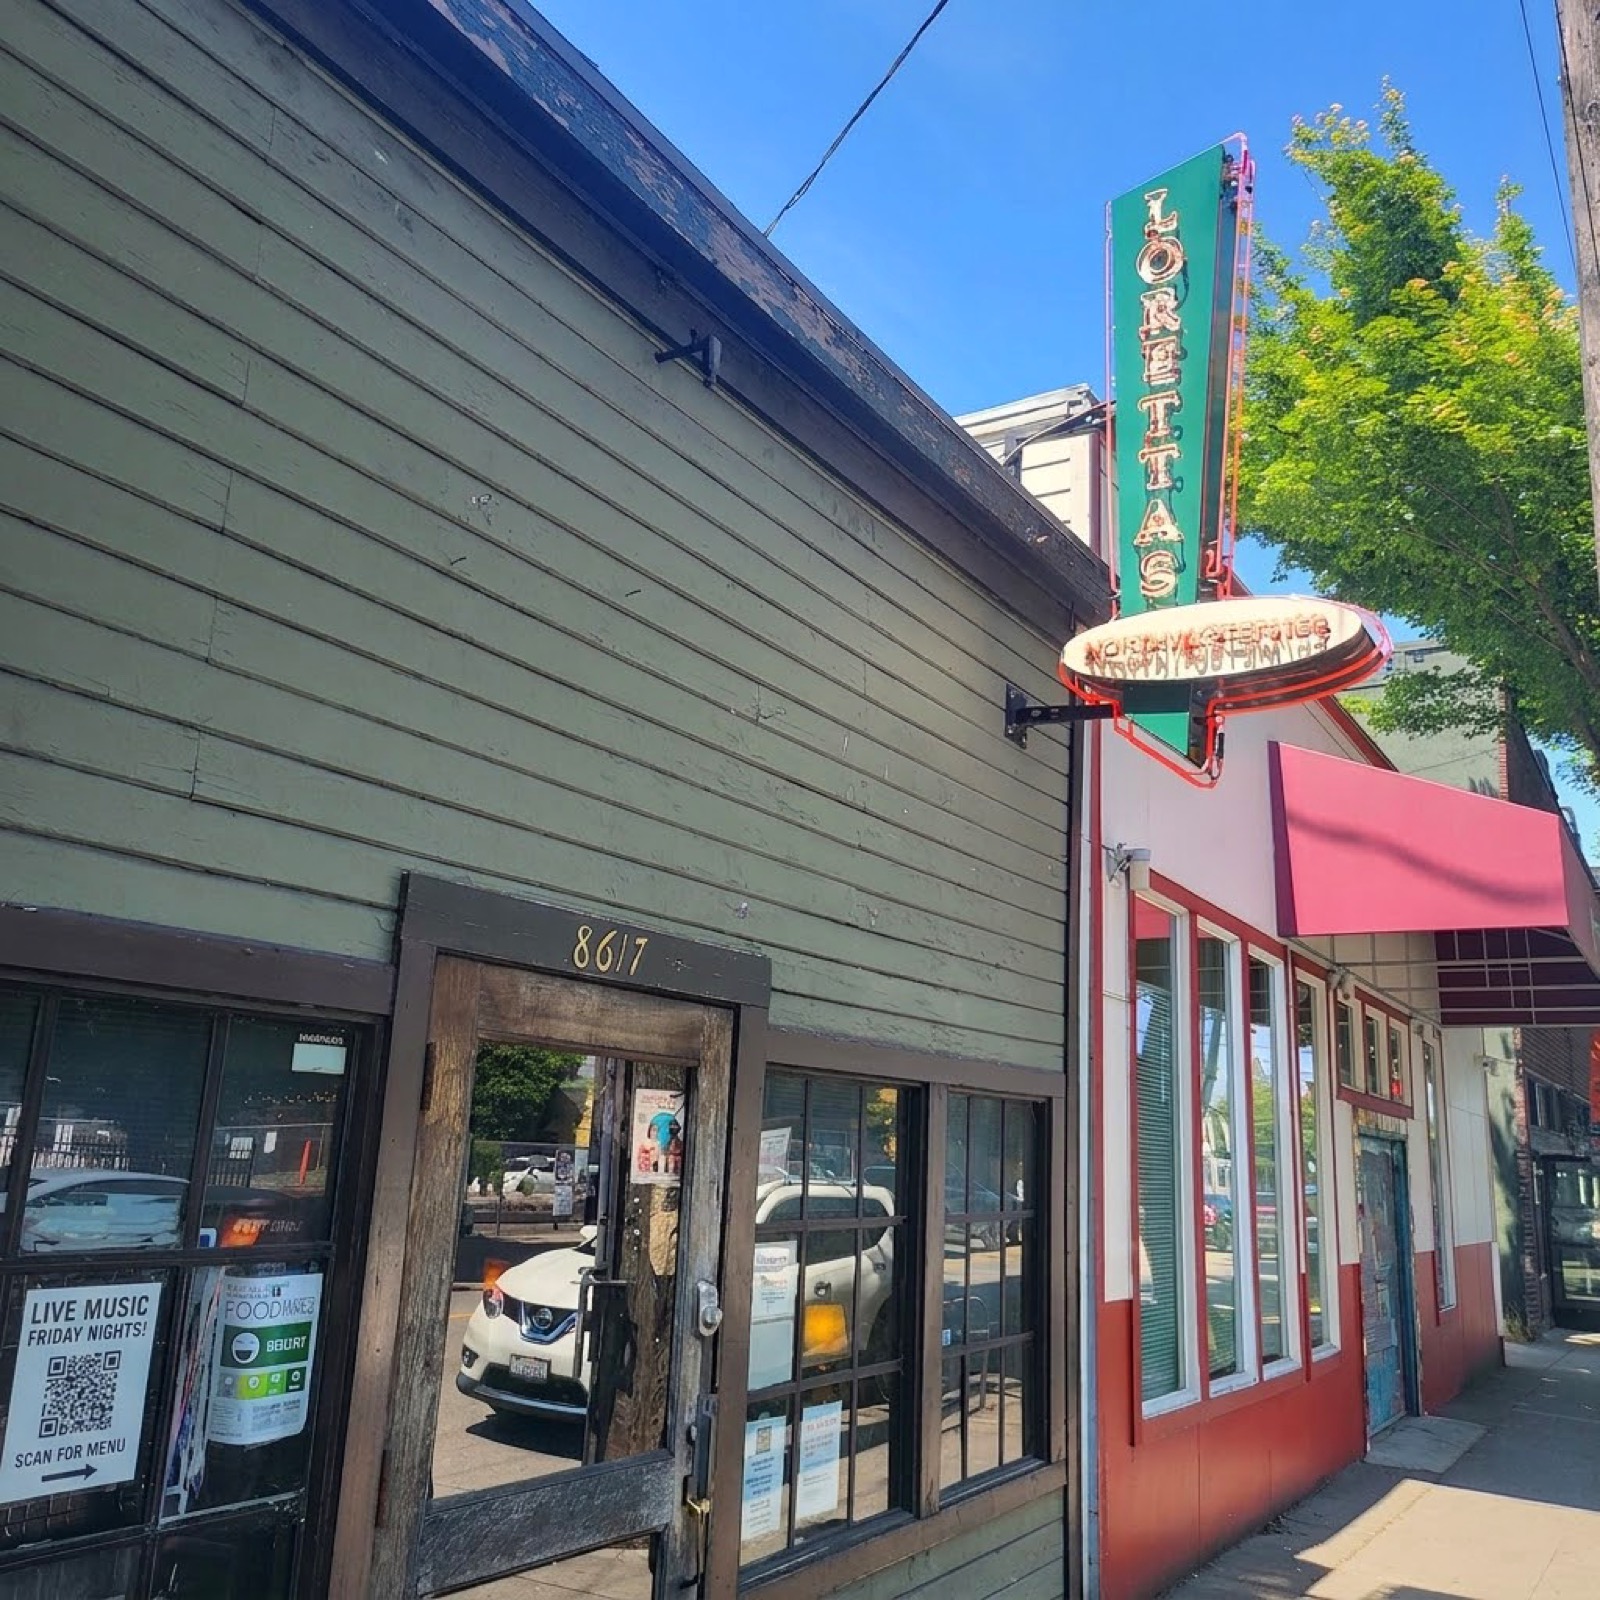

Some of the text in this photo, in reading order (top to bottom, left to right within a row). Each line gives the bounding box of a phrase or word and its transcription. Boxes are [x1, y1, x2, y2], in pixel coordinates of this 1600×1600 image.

[1134, 188, 1185, 598] LORETTAS
[574, 925, 648, 976] 8617
[31, 1295, 149, 1324] LIVE MUSIC
[27, 1321, 147, 1346] FRIDAY NIGHTS!
[15, 1438, 126, 1468] SCAN FOR MENU
